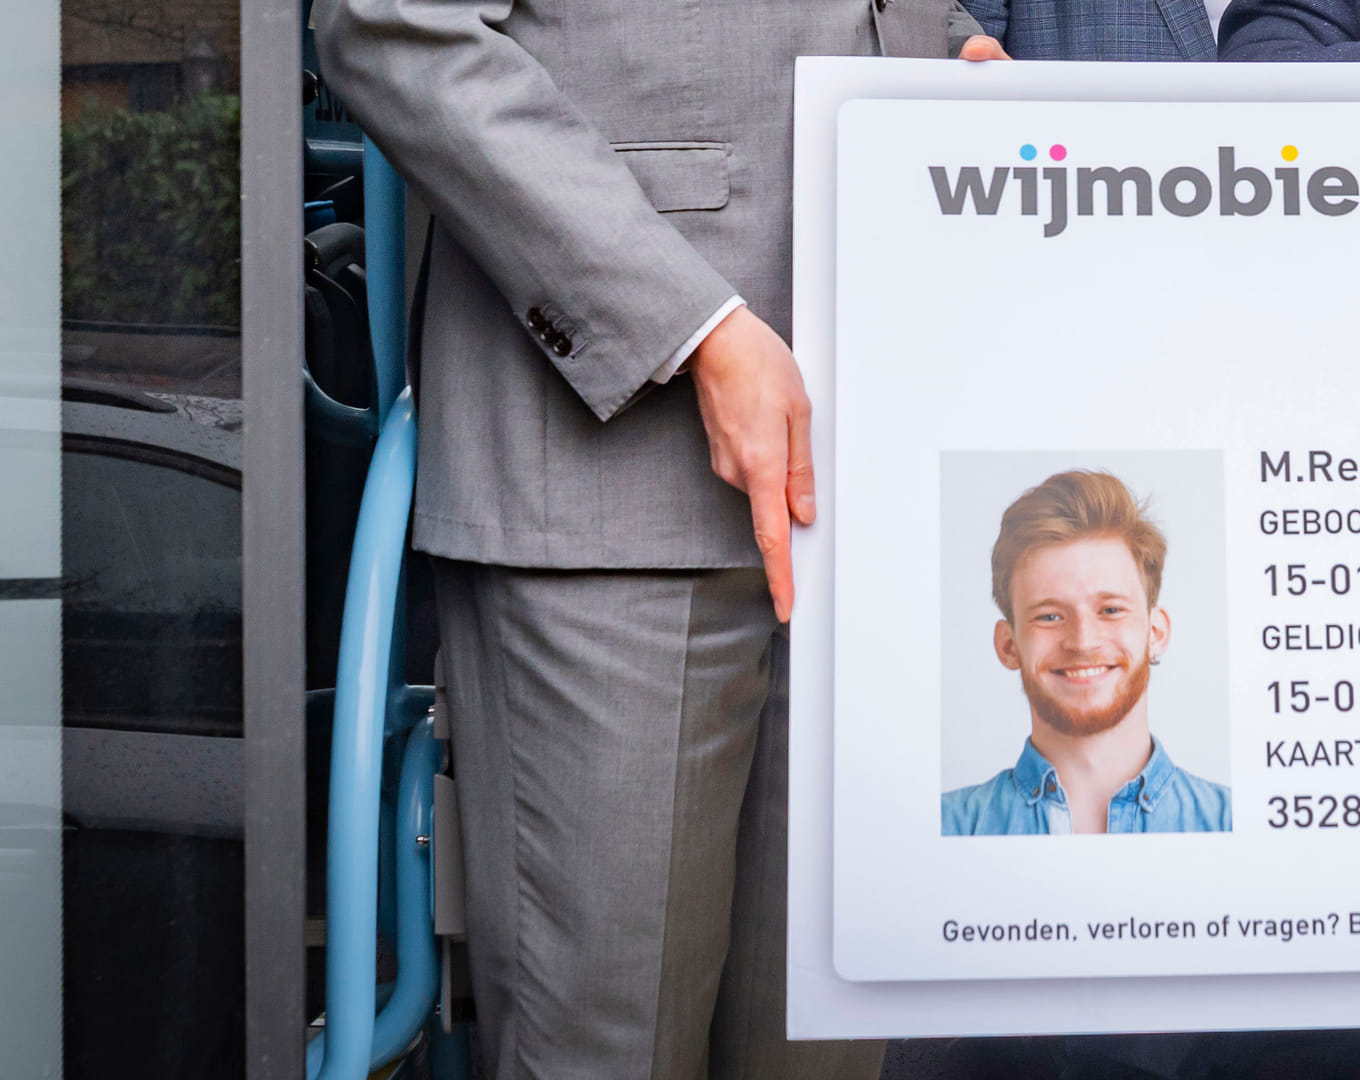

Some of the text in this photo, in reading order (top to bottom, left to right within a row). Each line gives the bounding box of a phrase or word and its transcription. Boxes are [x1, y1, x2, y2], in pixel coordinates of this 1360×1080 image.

[941, 918, 1077, 944] Gevonden,
[1087, 916, 1196, 940] verloren
[1206, 915, 1230, 937] of
[1237, 913, 1340, 942] vragen?
